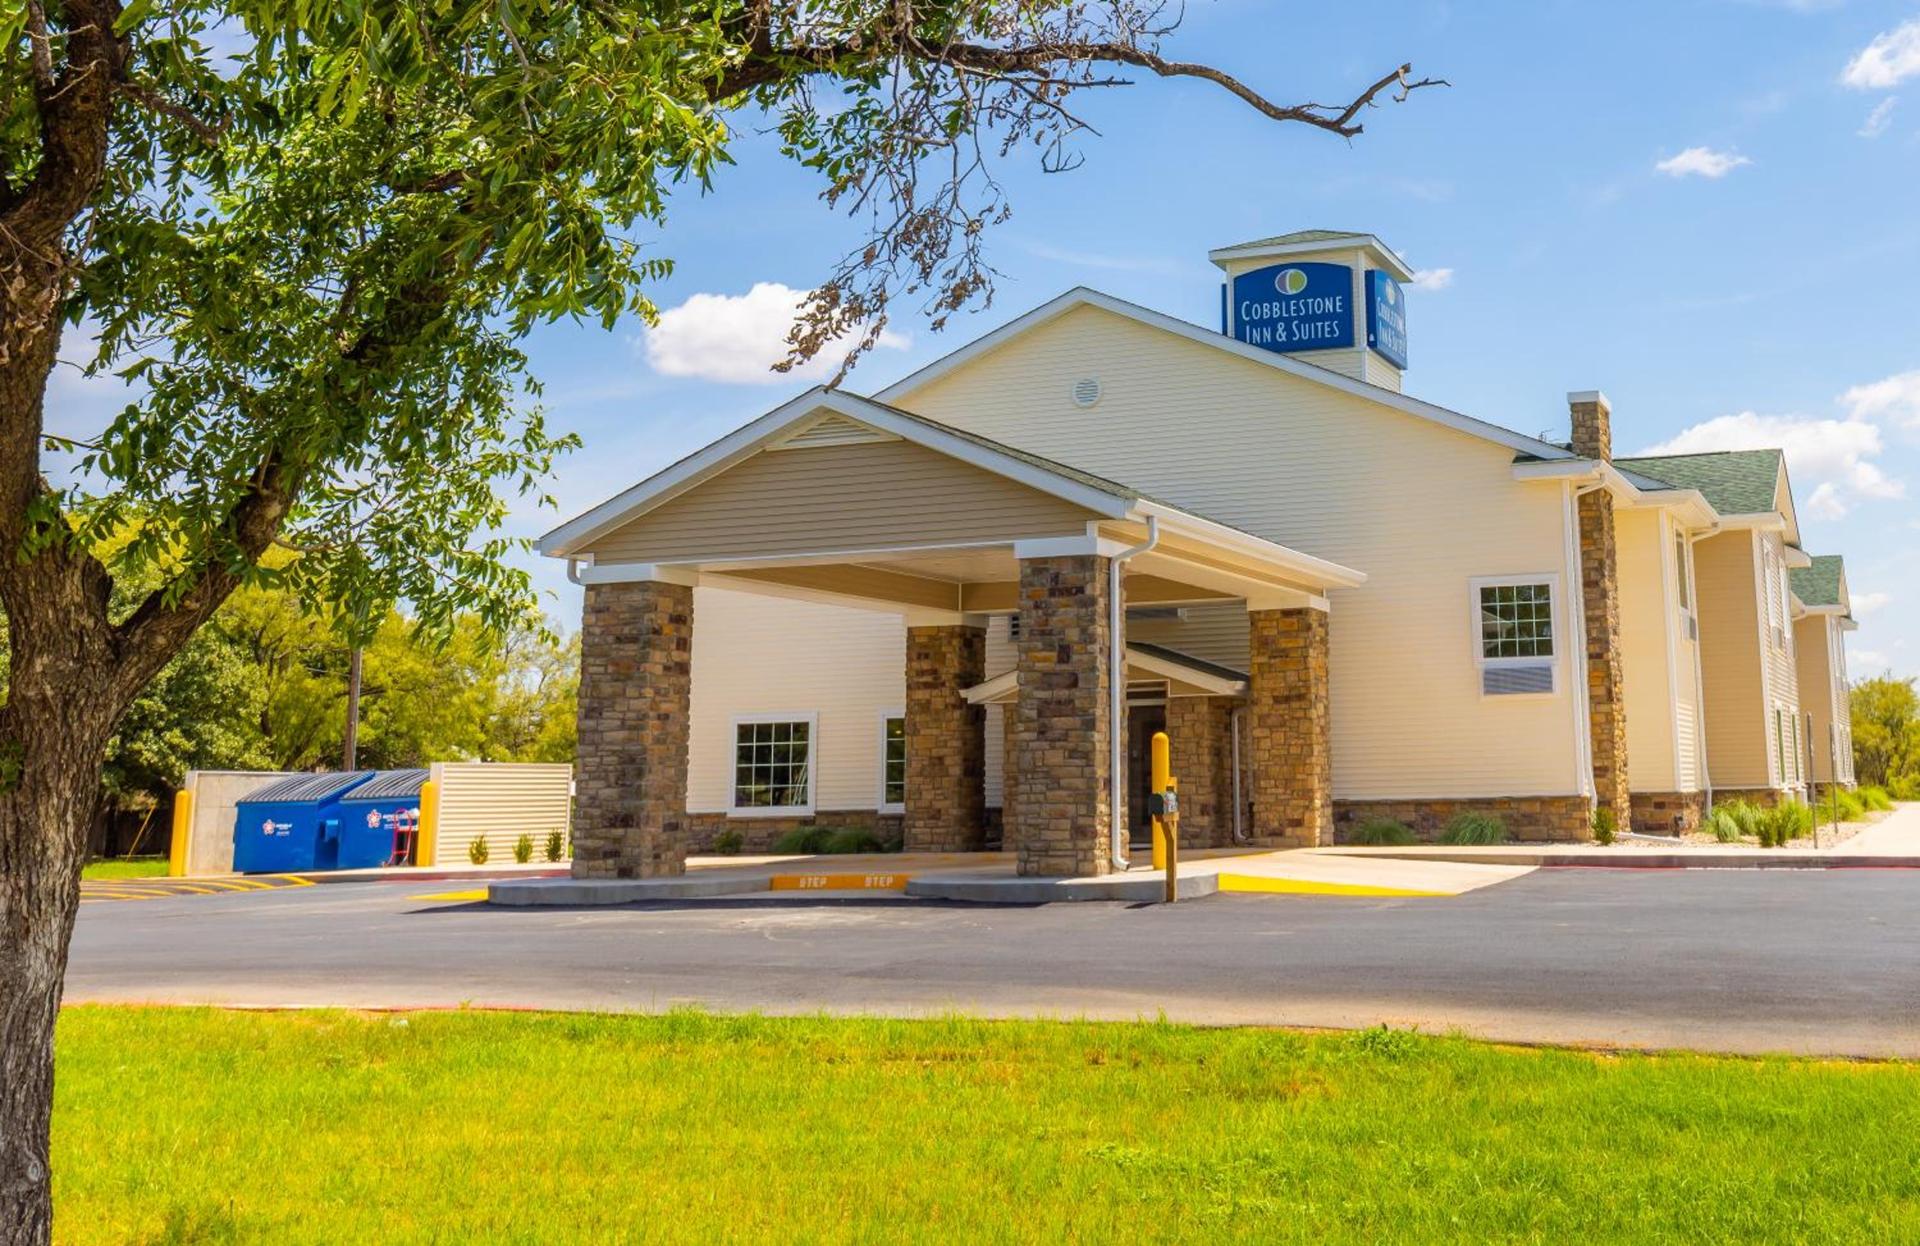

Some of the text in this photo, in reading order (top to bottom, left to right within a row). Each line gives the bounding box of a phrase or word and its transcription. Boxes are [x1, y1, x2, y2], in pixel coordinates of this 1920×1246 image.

[1241, 296, 1343, 321] COBBLESTONE
[1246, 320, 1340, 344] INN & SUITES
[799, 876, 893, 888] STEP STEP
